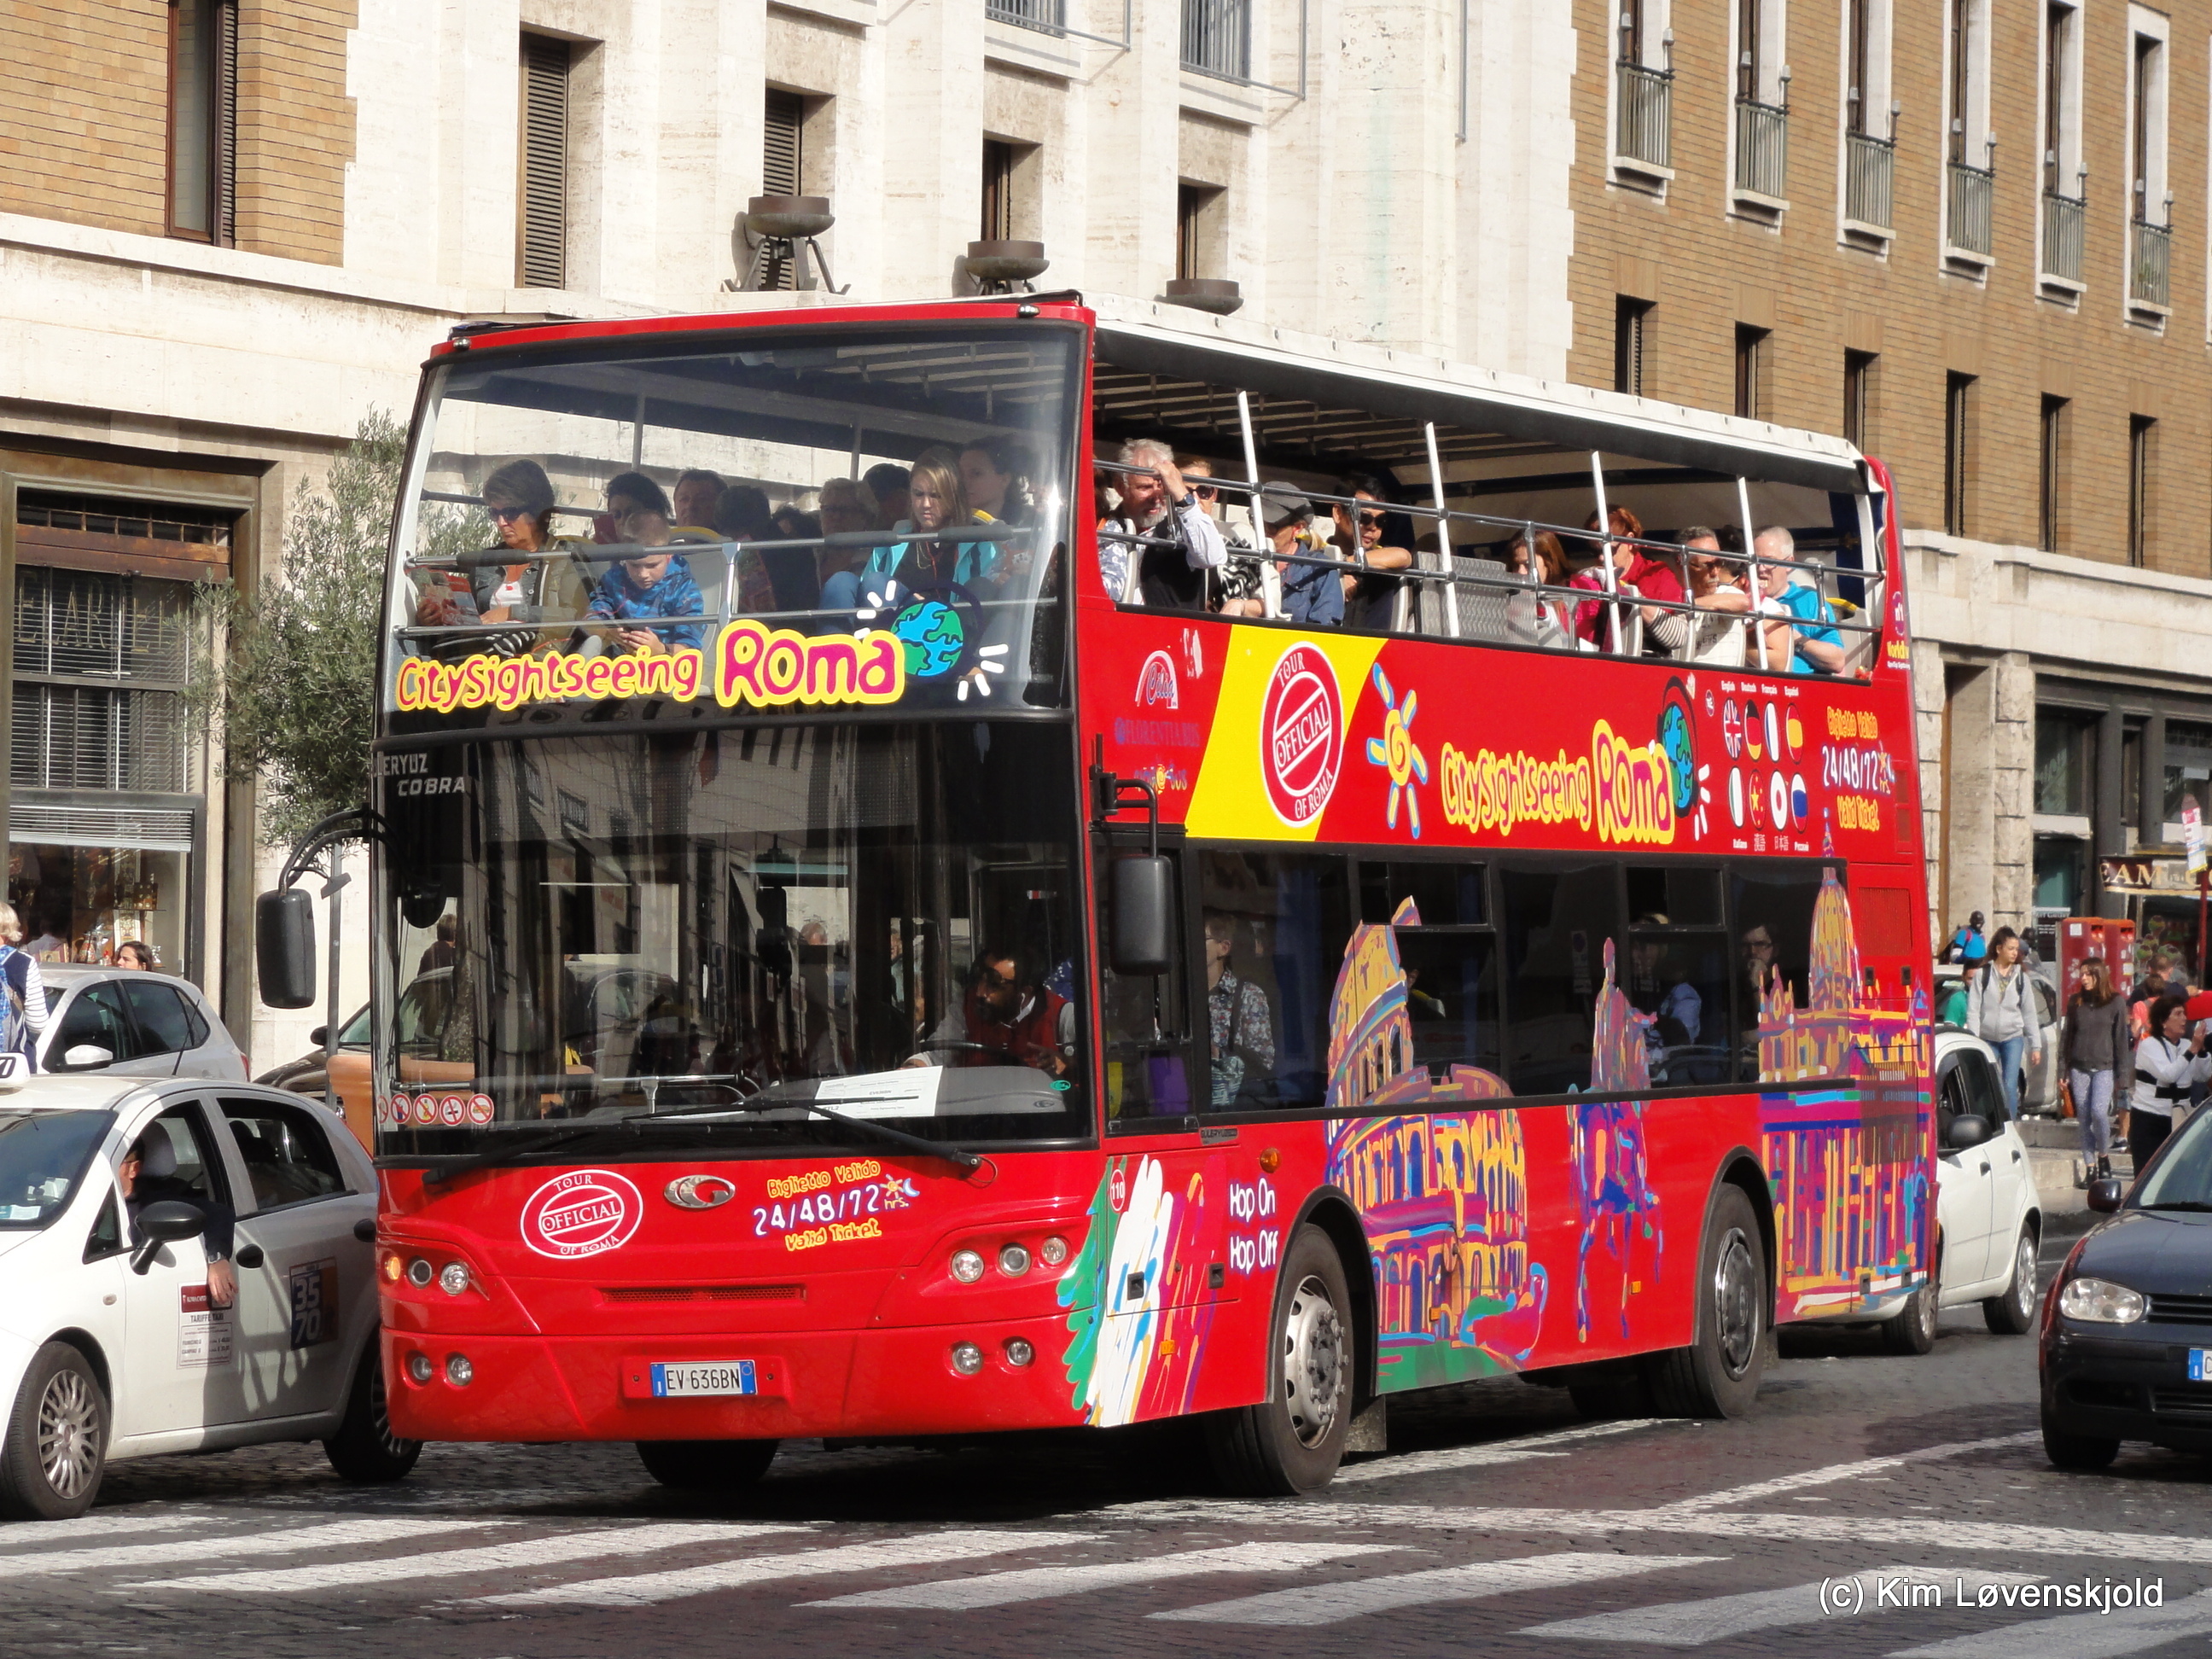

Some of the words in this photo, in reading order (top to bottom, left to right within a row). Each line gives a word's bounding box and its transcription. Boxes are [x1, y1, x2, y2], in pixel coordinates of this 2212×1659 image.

[396, 646, 703, 713] CitySightseeing
[715, 619, 905, 707] Roma
[1277, 652, 1306, 688] TOUR
[1275, 701, 1330, 768] OFFICIAL
[1441, 742, 1592, 836] CitySightseeing
[1592, 719, 1675, 845] Roma
[1822, 745, 1878, 791] 24/48/72
[397, 777, 466, 797] COBRA
[1295, 797, 1307, 819] OF
[1308, 767, 1334, 812] ROMA
[553, 1174, 594, 1192] TOUR
[766, 1170, 832, 1199] Biglietto
[835, 1160, 882, 1184] Valido
[1109, 1180, 1125, 1200] 110
[541, 1201, 620, 1231] OFFICIAL
[753, 1185, 880, 1236] 24/48/72
[884, 1197, 910, 1210] hrs.
[1230, 1182, 1255, 1223] Hop
[1258, 1177, 1277, 1216] On
[560, 1245, 576, 1255] OF
[580, 1234, 620, 1254] ROMA
[785, 1227, 828, 1252] Valid
[829, 1217, 882, 1242] Ticket
[1230, 1235, 1255, 1274] Hop
[1259, 1230, 1279, 1269] Off
[292, 1275, 321, 1312] 35
[294, 1308, 321, 1344] 70
[666, 1369, 684, 1390] EV
[690, 1368, 741, 1390] 636BN
